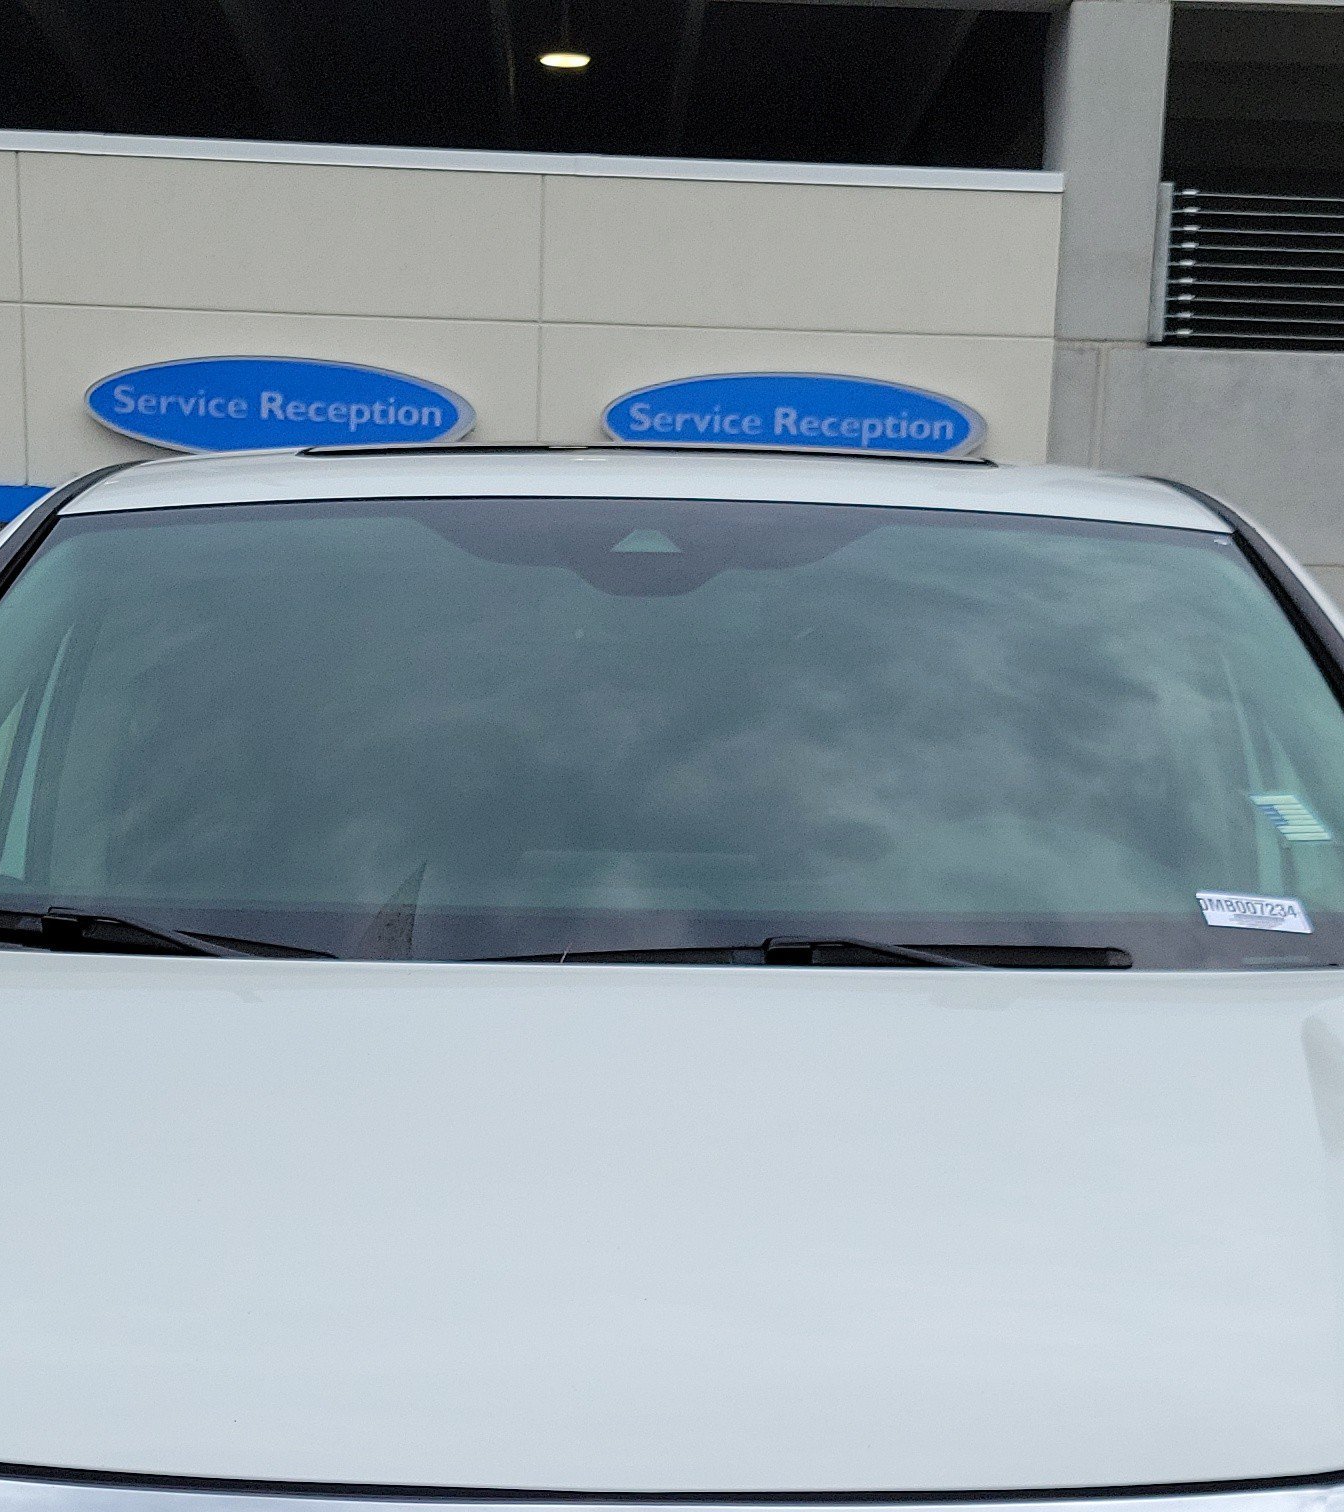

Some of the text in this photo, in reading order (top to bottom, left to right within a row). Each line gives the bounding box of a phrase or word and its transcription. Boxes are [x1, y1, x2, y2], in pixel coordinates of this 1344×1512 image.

[113, 384, 443, 432] Service Reception
[629, 402, 955, 448] Service Reception
